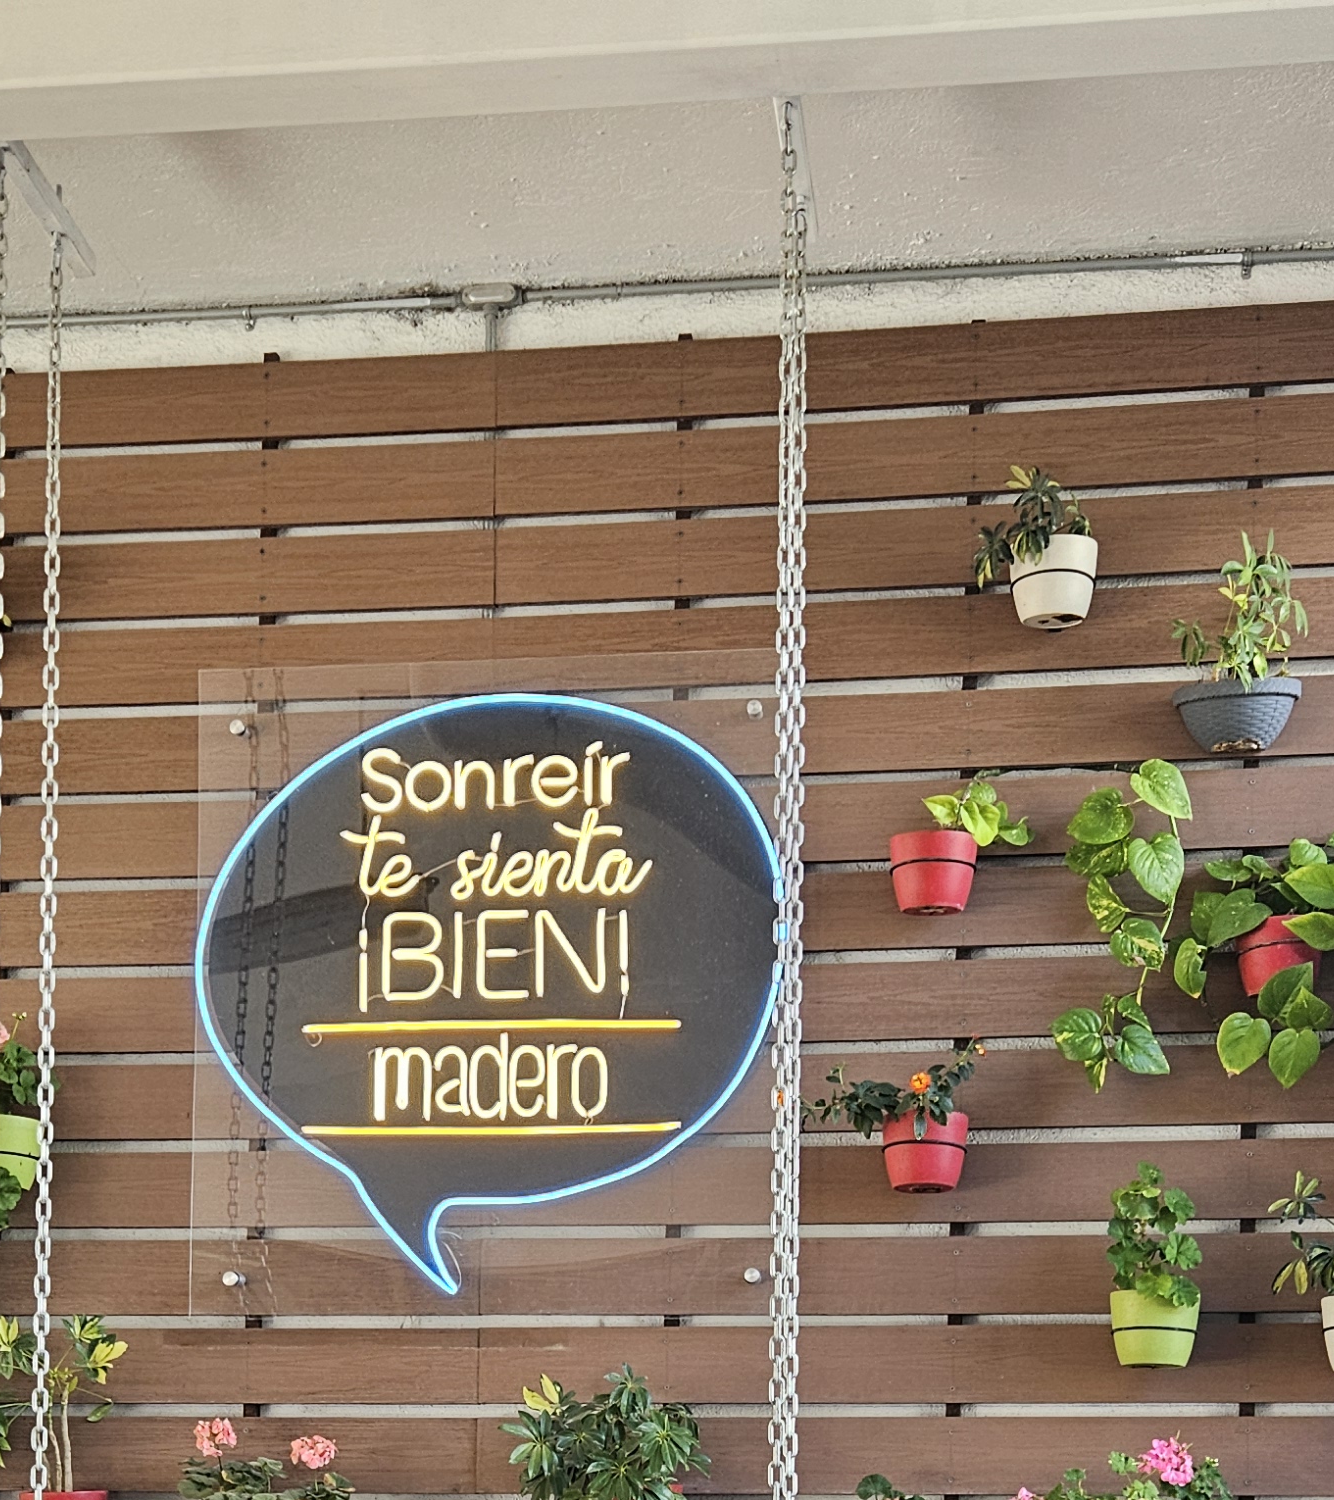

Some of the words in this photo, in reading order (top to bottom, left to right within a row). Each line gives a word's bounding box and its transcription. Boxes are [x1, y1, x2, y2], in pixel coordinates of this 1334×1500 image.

[360, 741, 630, 812] Sonreír
[341, 815, 419, 898] te
[450, 808, 652, 900] sienta
[358, 907, 629, 1013] ¡BIEN!
[372, 1033, 607, 1120] madero
